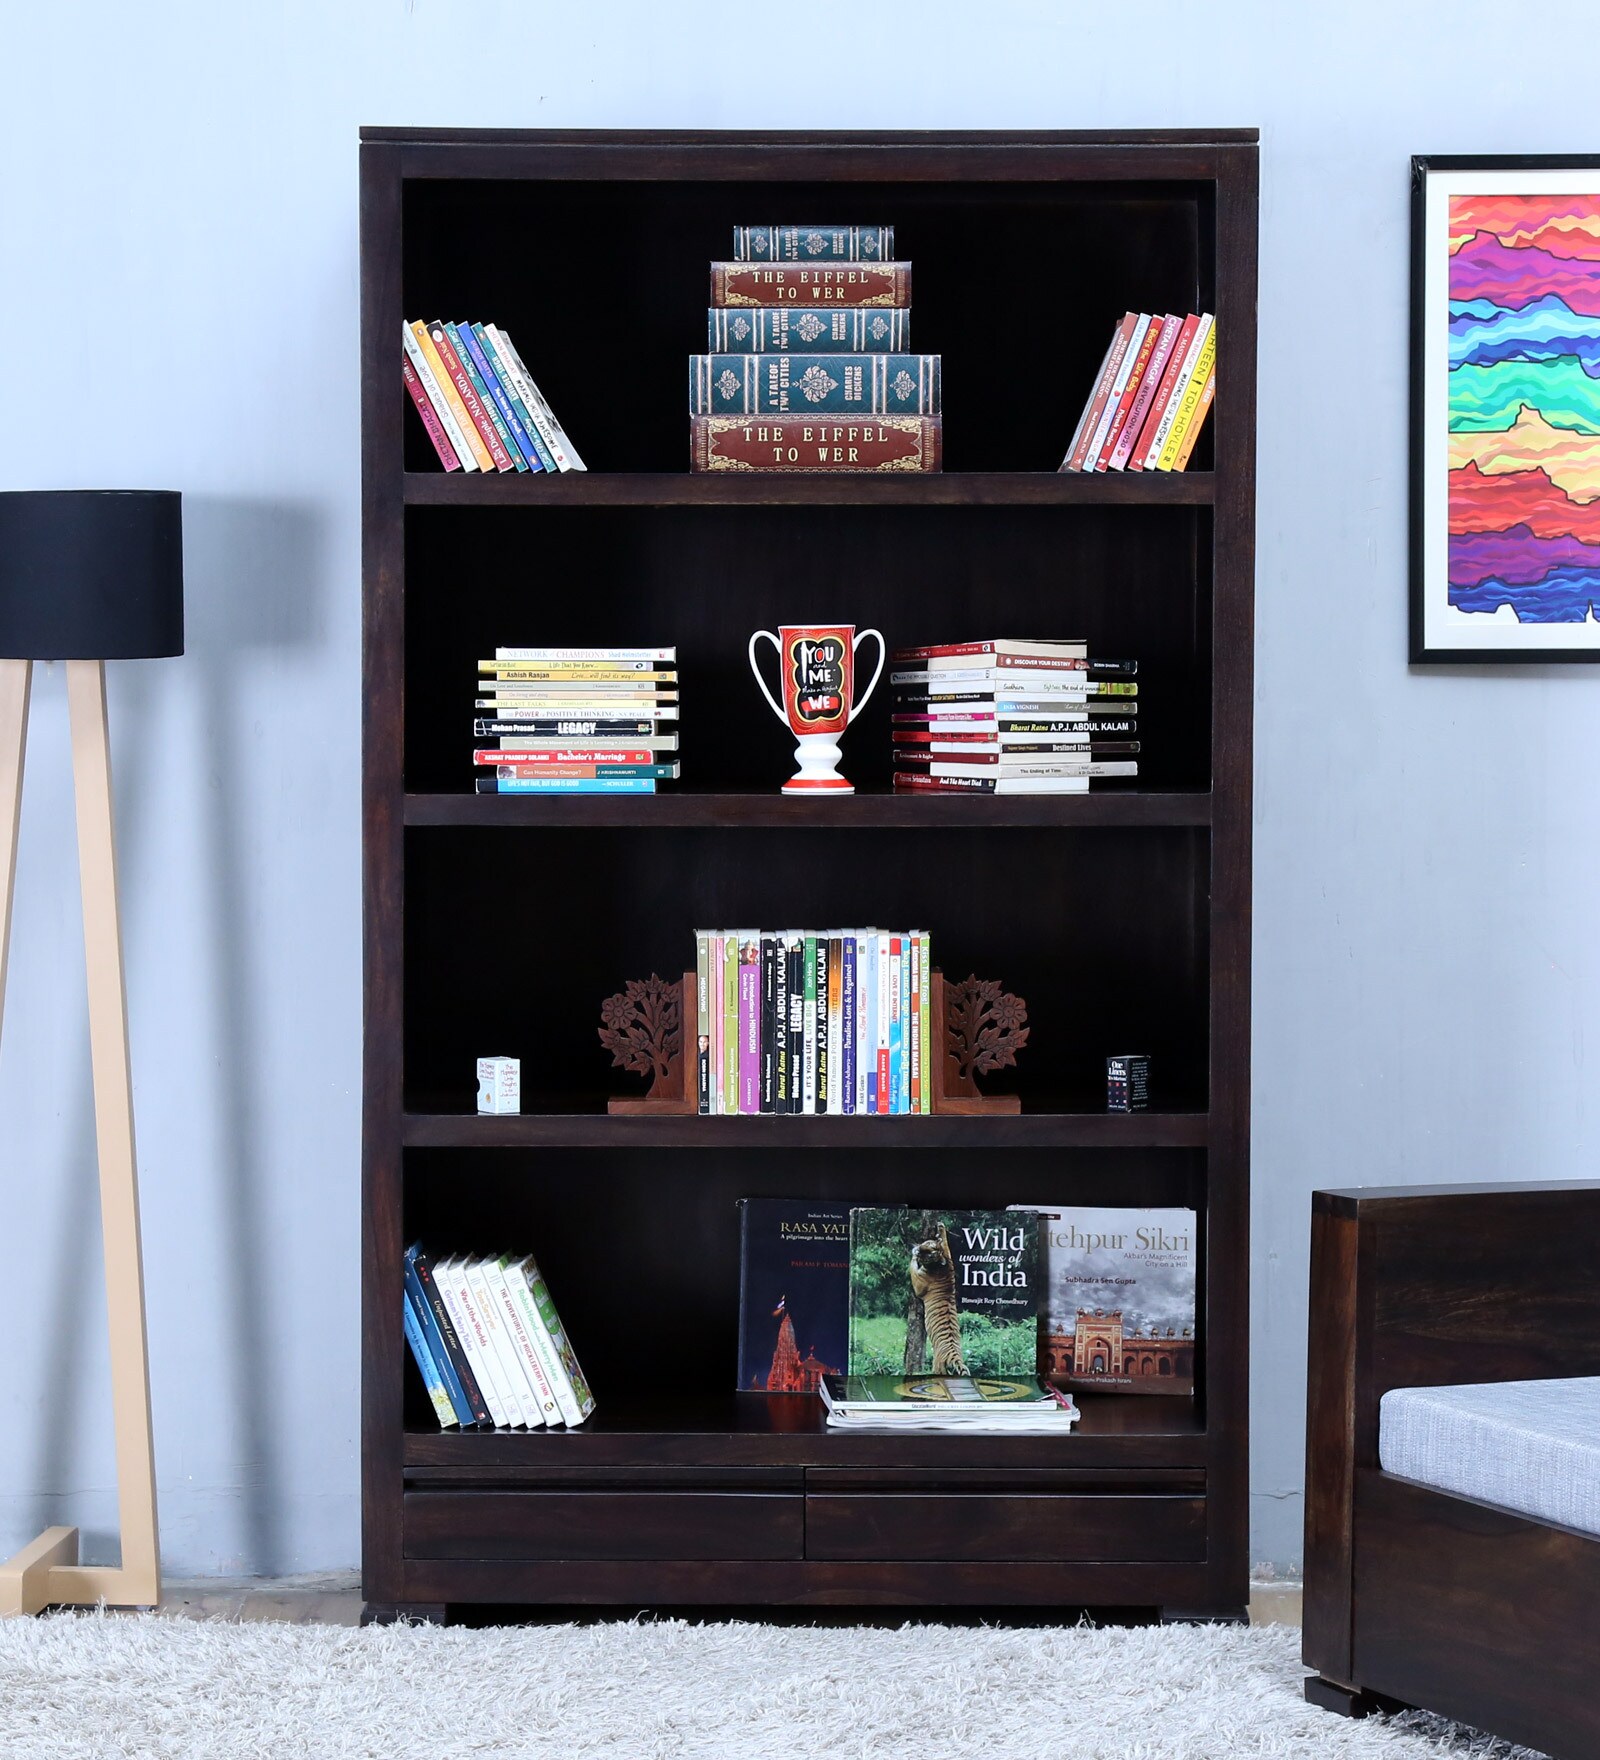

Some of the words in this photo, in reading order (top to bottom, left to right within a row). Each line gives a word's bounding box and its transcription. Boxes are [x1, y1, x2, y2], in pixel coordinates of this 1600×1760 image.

[752, 271, 786, 283] THE
[800, 271, 869, 284] EIFFEL
[776, 287, 798, 299] TO
[812, 287, 845, 299] WER
[772, 312, 780, 336] TALEOF
[780, 308, 789, 331] CITIES
[831, 312, 839, 340] CHARLES
[1195, 318, 1210, 345] CHETAN
[1157, 316, 1178, 352] CHETAN
[487, 326, 506, 352] CHETAN
[500, 350, 519, 376] BHAGAT
[490, 354, 506, 374] SINGH
[1185, 343, 1201, 369] BHAGAT
[417, 365, 433, 385] Love
[769, 363, 779, 395] TALEOF
[780, 357, 790, 388] CITIES
[1145, 350, 1165, 386] BHAGAT
[453, 372, 484, 418] NALANDA
[500, 373, 520, 401] RAVINDER
[844, 366, 853, 400] CHARLES
[853, 366, 862, 400] DICKENS
[430, 391, 450, 419] Shades
[769, 396, 778, 406] A
[780, 390, 790, 411] TWO
[1127, 384, 1151, 431] REVOLUTION
[1154, 387, 1170, 413] RICHES
[1182, 388, 1199, 414] TOM
[419, 401, 440, 434] BHAGAT
[450, 400, 471, 428] DATTA
[480, 394, 500, 422] RAVINDER
[494, 420, 510, 440] SINGH
[514, 378, 533, 404] MAKING
[537, 419, 559, 451] AWESOME
[478, 418, 502, 450] Disciple
[742, 427, 784, 442] THE
[802, 427, 889, 442] EIFFEL
[1120, 429, 1133, 450] 2020
[1153, 415, 1172, 449] AWESOME
[1166, 415, 1188, 455] HOYLE
[434, 433, 455, 467] CHETAN
[773, 447, 799, 462] TO
[818, 447, 859, 462] WER
[507, 650, 548, 658] NETWORK
[556, 650, 605, 659] CHAMPIONS
[807, 646, 834, 664] YOU
[1038, 659, 1051, 667] YOUR
[808, 696, 831, 710] WE
[491, 724, 512, 732] Mohan
[513, 724, 535, 732] Prasad
[557, 722, 596, 734] LEGACY
[1010, 723, 1030, 732] Bharat
[1031, 723, 1049, 732] Ratna
[1050, 723, 1071, 732] A.P.J.
[1073, 723, 1100, 731] ABDUL
[1101, 722, 1129, 731] KALAM
[594, 752, 626, 761] Marriage
[1052, 744, 1077, 752] Destined
[1077, 744, 1092, 752] Lives
[777, 947, 786, 984] KALAM
[818, 948, 826, 984] KALAM
[921, 946, 929, 963] Kiss
[845, 963, 854, 995] Regained
[921, 965, 929, 983] That
[777, 985, 786, 1020] ABDUL
[818, 986, 826, 1021] ABDUL
[845, 996, 852, 1004] &
[920, 986, 929, 1005] Frog!
[790, 993, 803, 1033] LEGACY
[748, 1019, 756, 1054] HINDUISM
[777, 1022, 786, 1049] A.P.J.
[818, 1022, 827, 1049] A.P.J.
[844, 1020, 852, 1048] Paradise
[778, 1050, 786, 1073] Ratna
[792, 1054, 800, 1076] Prasad
[819, 1051, 827, 1074] Ratna
[778, 1074, 786, 1100] Bharat
[792, 1076, 800, 1098] Mohan
[819, 1074, 827, 1100] Bharat
[781, 1222, 817, 1233] RASA
[961, 1227, 1026, 1251] Wild
[1049, 1225, 1128, 1254] tehpur
[1135, 1227, 1189, 1251] Sikri
[959, 1250, 1007, 1263] wonders
[1008, 1250, 1022, 1268] of
[1124, 1252, 1147, 1260] Akbar's
[1149, 1252, 1188, 1261] Magnificent
[1145, 1260, 1159, 1268] City
[961, 1263, 1028, 1288] India
[1065, 1276, 1099, 1284] Subhadra
[1115, 1278, 1136, 1286] Gupta
[498, 1287, 509, 1300] THE
[961, 1297, 983, 1305] Biswajit
[984, 1297, 995, 1306] Roy
[995, 1297, 1028, 1306] Chowdhury
[432, 1299, 452, 1331] Unposted
[445, 1329, 460, 1351] Letter
[442, 1288, 461, 1318] Grimm's
[452, 1316, 468, 1336] Fairy
[461, 1333, 475, 1352] Tales
[458, 1288, 471, 1305] War
[472, 1321, 490, 1348] Worlds
[503, 1298, 525, 1336] ADVENTURES
[516, 1288, 533, 1312] Robin
[525, 1309, 541, 1332] Hood
[537, 1341, 555, 1367] Merry
[547, 1363, 561, 1383] Men
[519, 1335, 528, 1343] OF
[522, 1342, 545, 1383] HUCKLEBERRY
[538, 1381, 551, 1398] FINN
